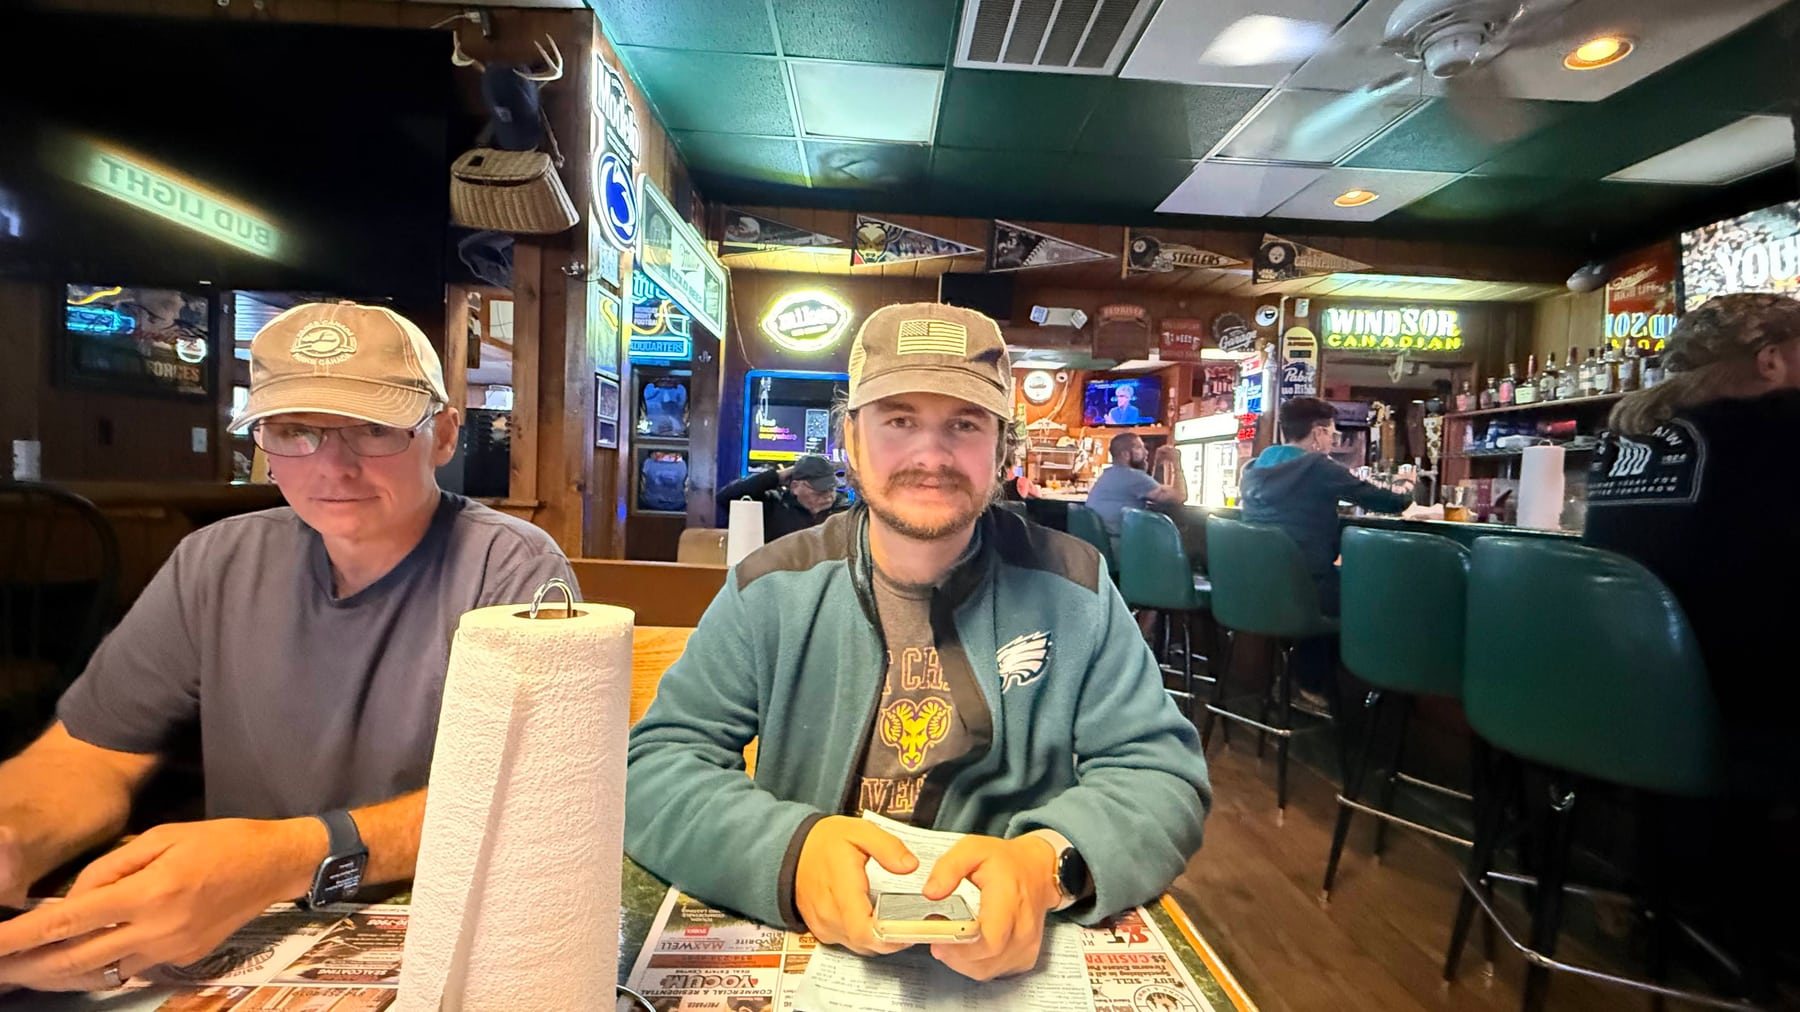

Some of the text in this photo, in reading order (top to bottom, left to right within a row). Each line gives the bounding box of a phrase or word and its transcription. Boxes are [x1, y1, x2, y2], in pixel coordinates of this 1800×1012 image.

[597, 57, 640, 160] Modelo
[1171, 251, 1221, 266] STEELERS
[1715, 235, 1800, 292] YOU
[1326, 307, 1461, 337] WINDSOR
[1219, 330, 1258, 350] Garage
[1327, 333, 1463, 350] CANADIAN
[1284, 366, 1314, 384] Pabst
[901, 647, 950, 692] CH
[659, 941, 725, 951] MAXWELL
[1108, 954, 1150, 964] CASH
[666, 975, 753, 989] YOCUM
[1152, 977, 1176, 985] BUY
